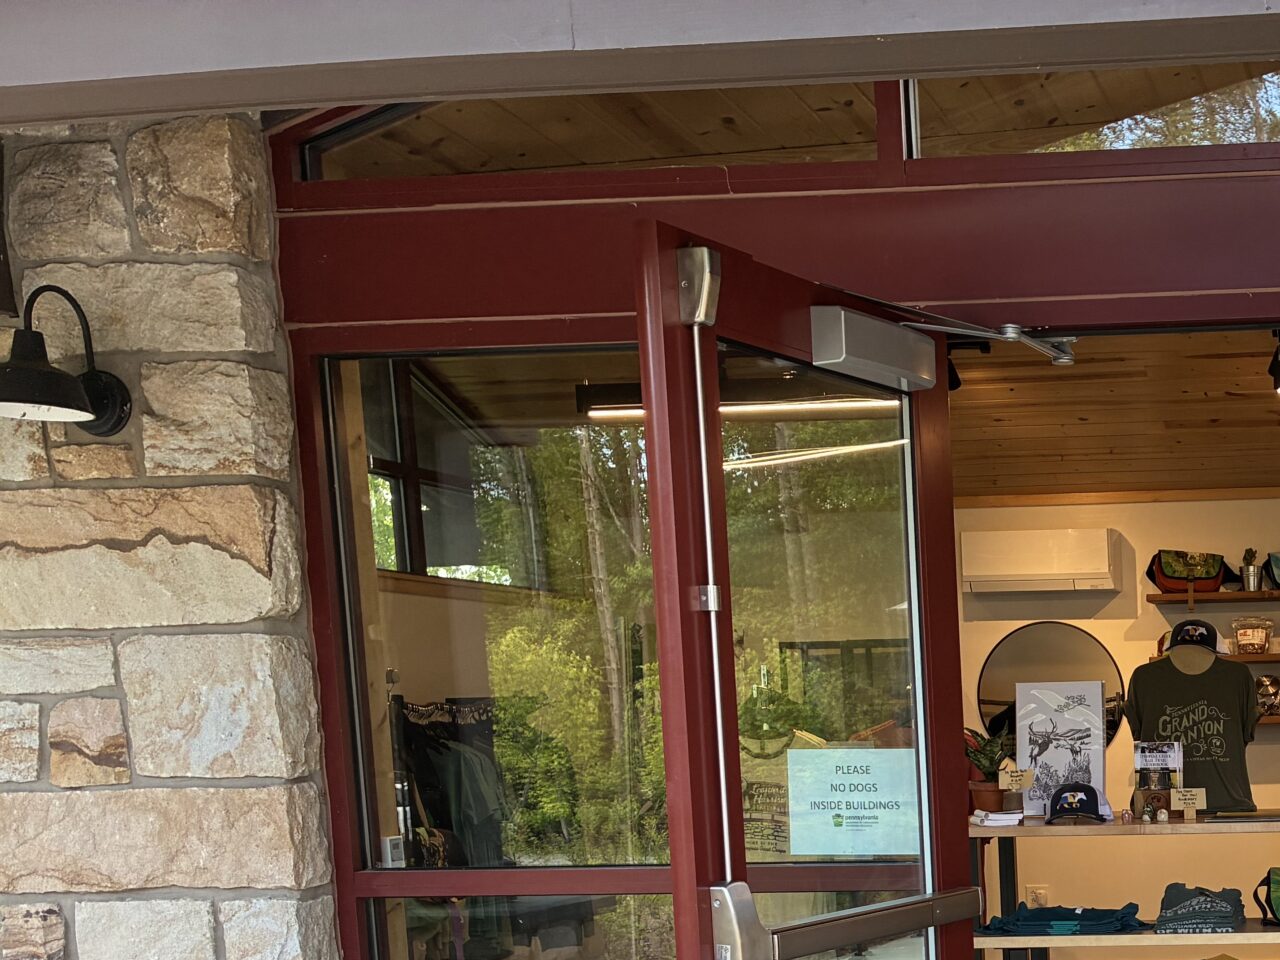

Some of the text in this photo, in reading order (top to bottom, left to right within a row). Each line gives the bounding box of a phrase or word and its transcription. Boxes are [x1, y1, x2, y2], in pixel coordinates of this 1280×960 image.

[1159, 705, 1208, 736] GRAND
[1170, 720, 1224, 745] CANYON
[835, 765, 872, 775] PLEASE
[830, 783, 878, 793] NO DOGS
[810, 801, 901, 811] INSIDE BUILDINGS
